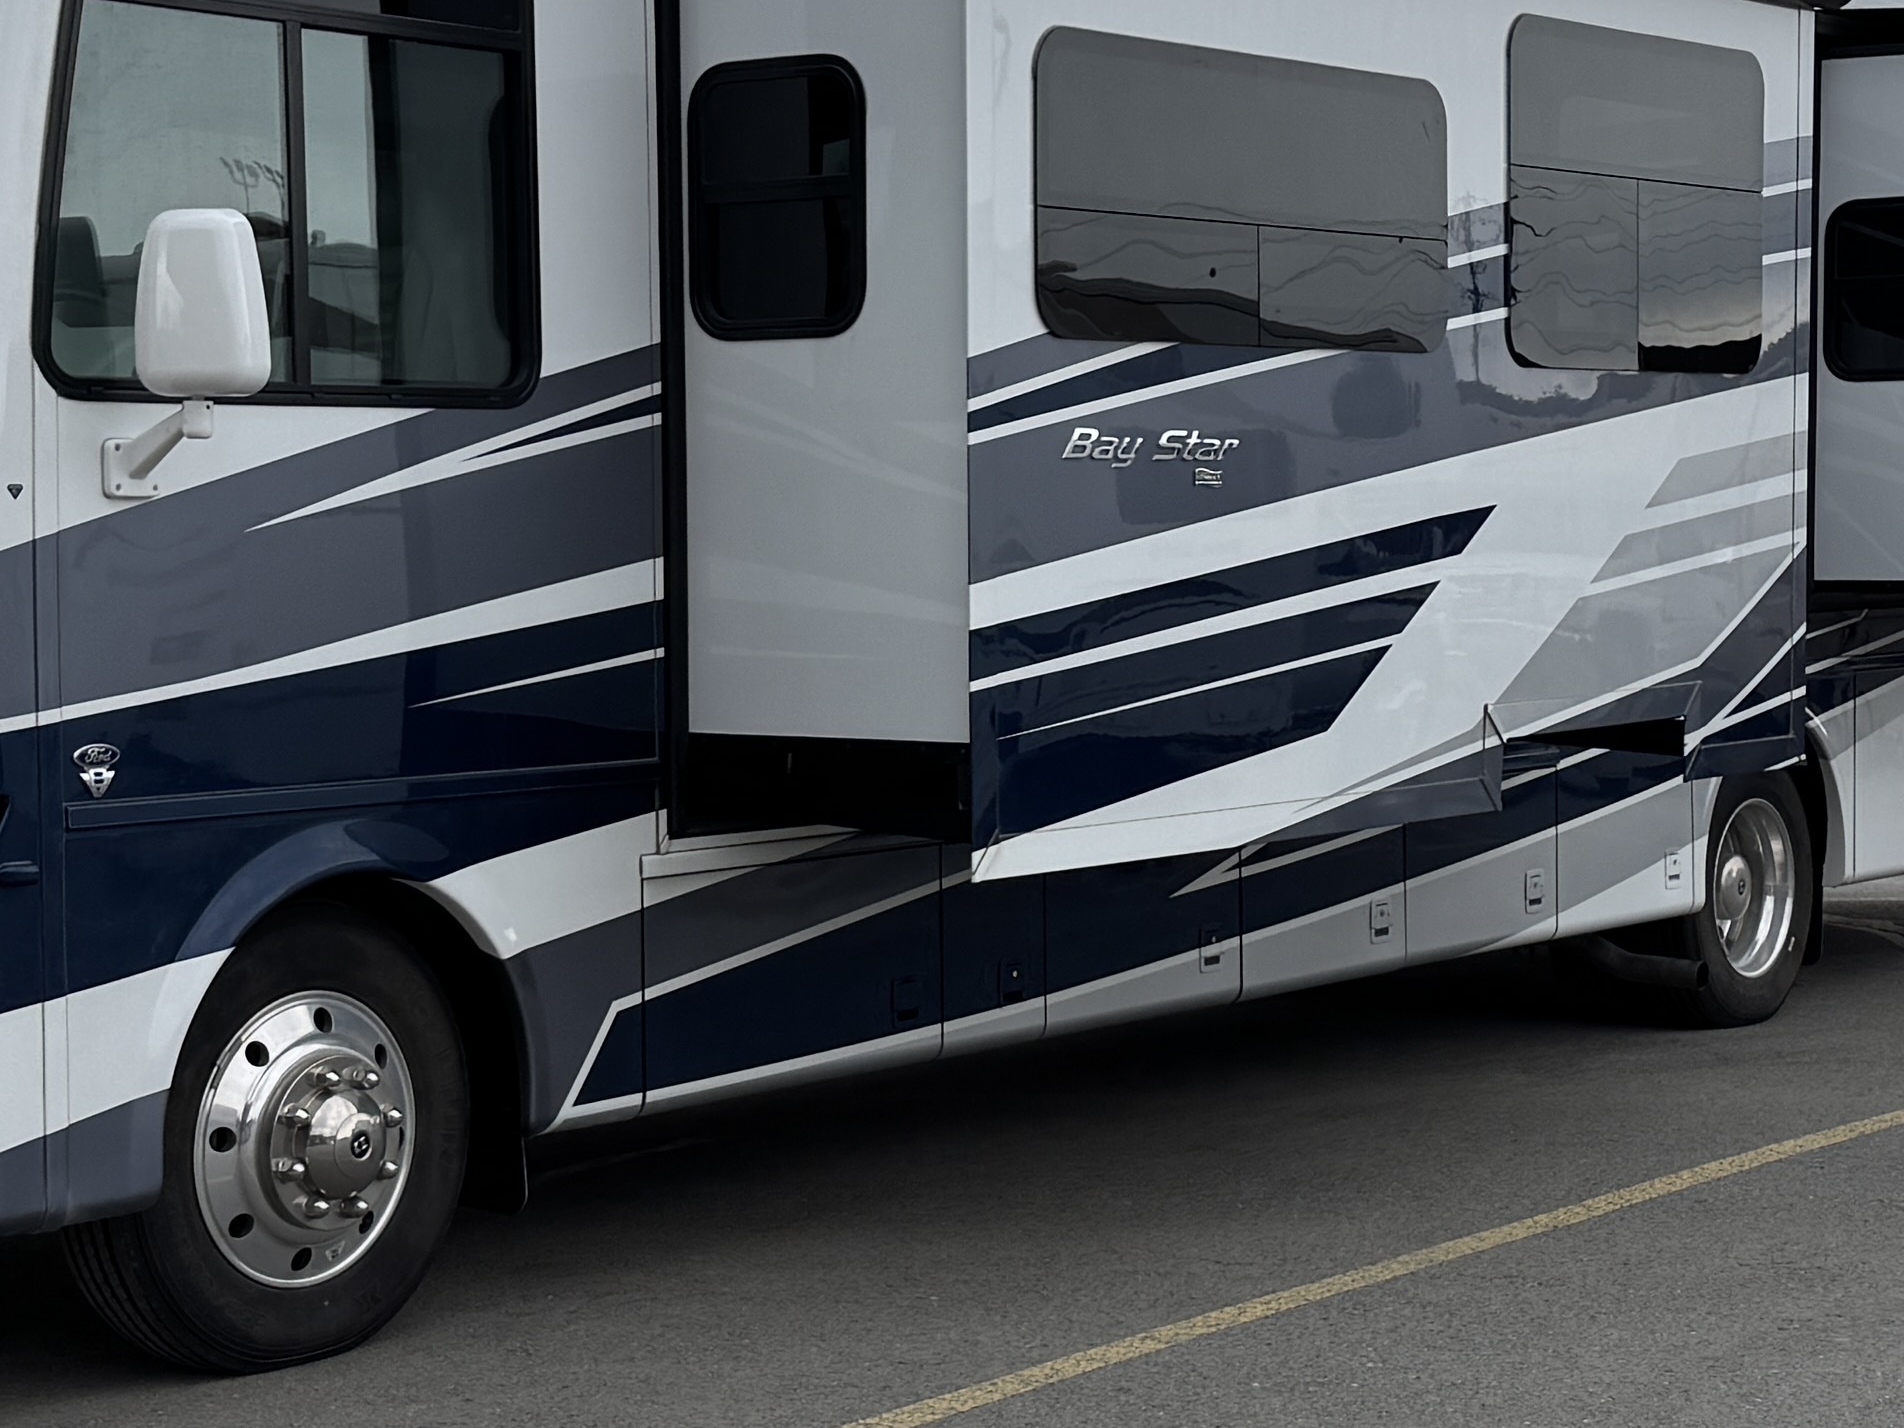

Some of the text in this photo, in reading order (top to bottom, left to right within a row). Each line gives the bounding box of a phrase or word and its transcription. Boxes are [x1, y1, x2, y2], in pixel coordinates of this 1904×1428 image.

[1061, 426, 1241, 469] Bay Star
[84, 746, 113, 764] Ford
